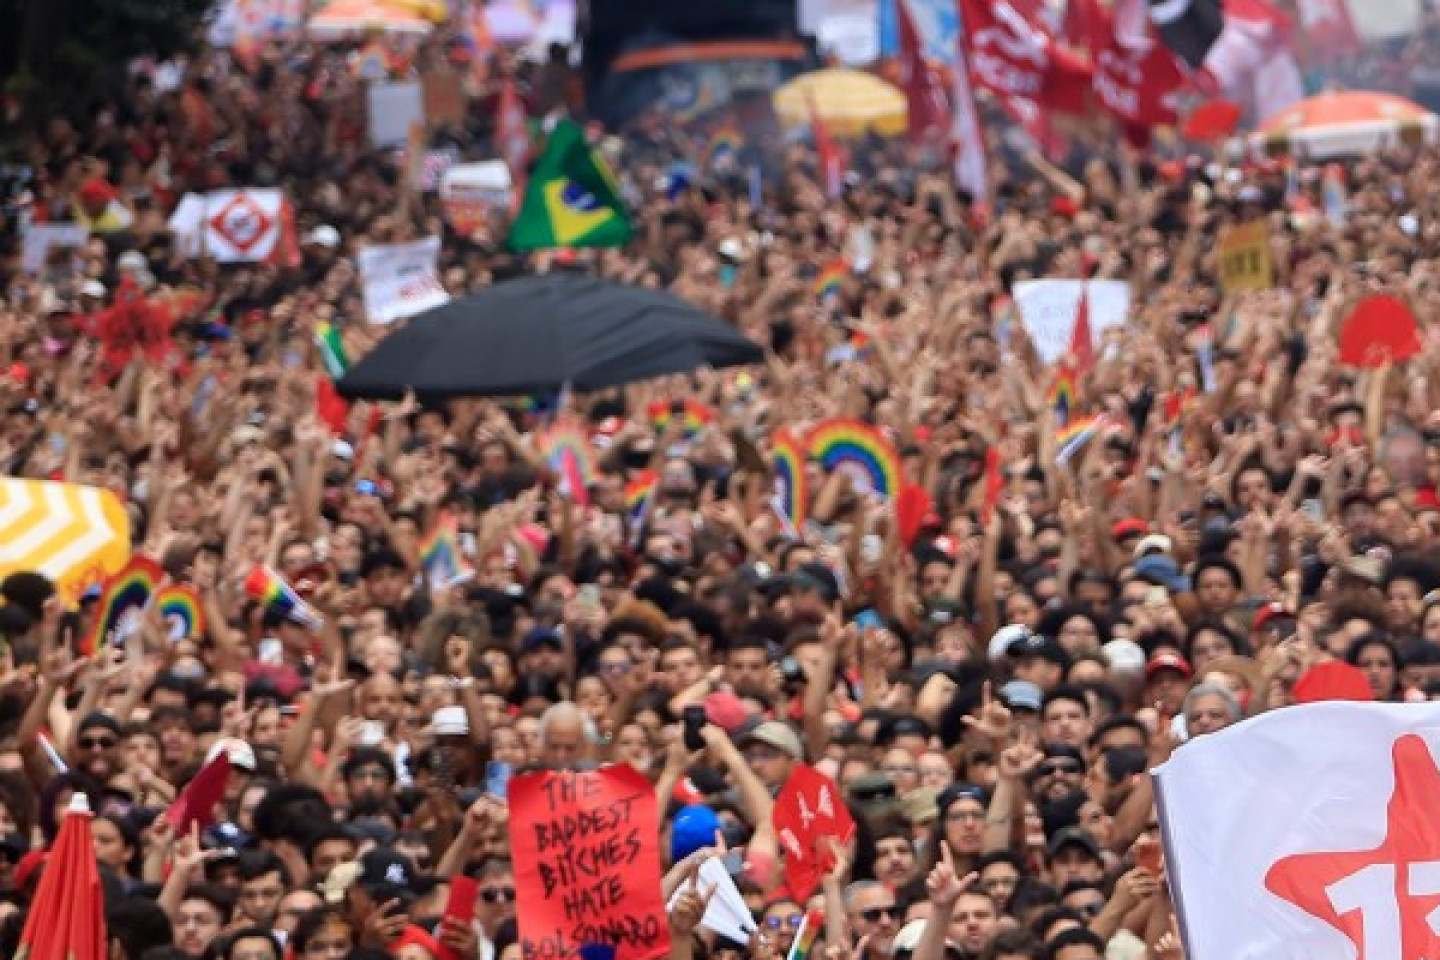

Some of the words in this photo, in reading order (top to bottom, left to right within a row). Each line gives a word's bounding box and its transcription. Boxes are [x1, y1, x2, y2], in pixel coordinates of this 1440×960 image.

[542, 777, 600, 810] THE
[535, 793, 642, 852] BADDEST
[538, 828, 641, 899] BITCHES
[562, 873, 625, 920] HATE
